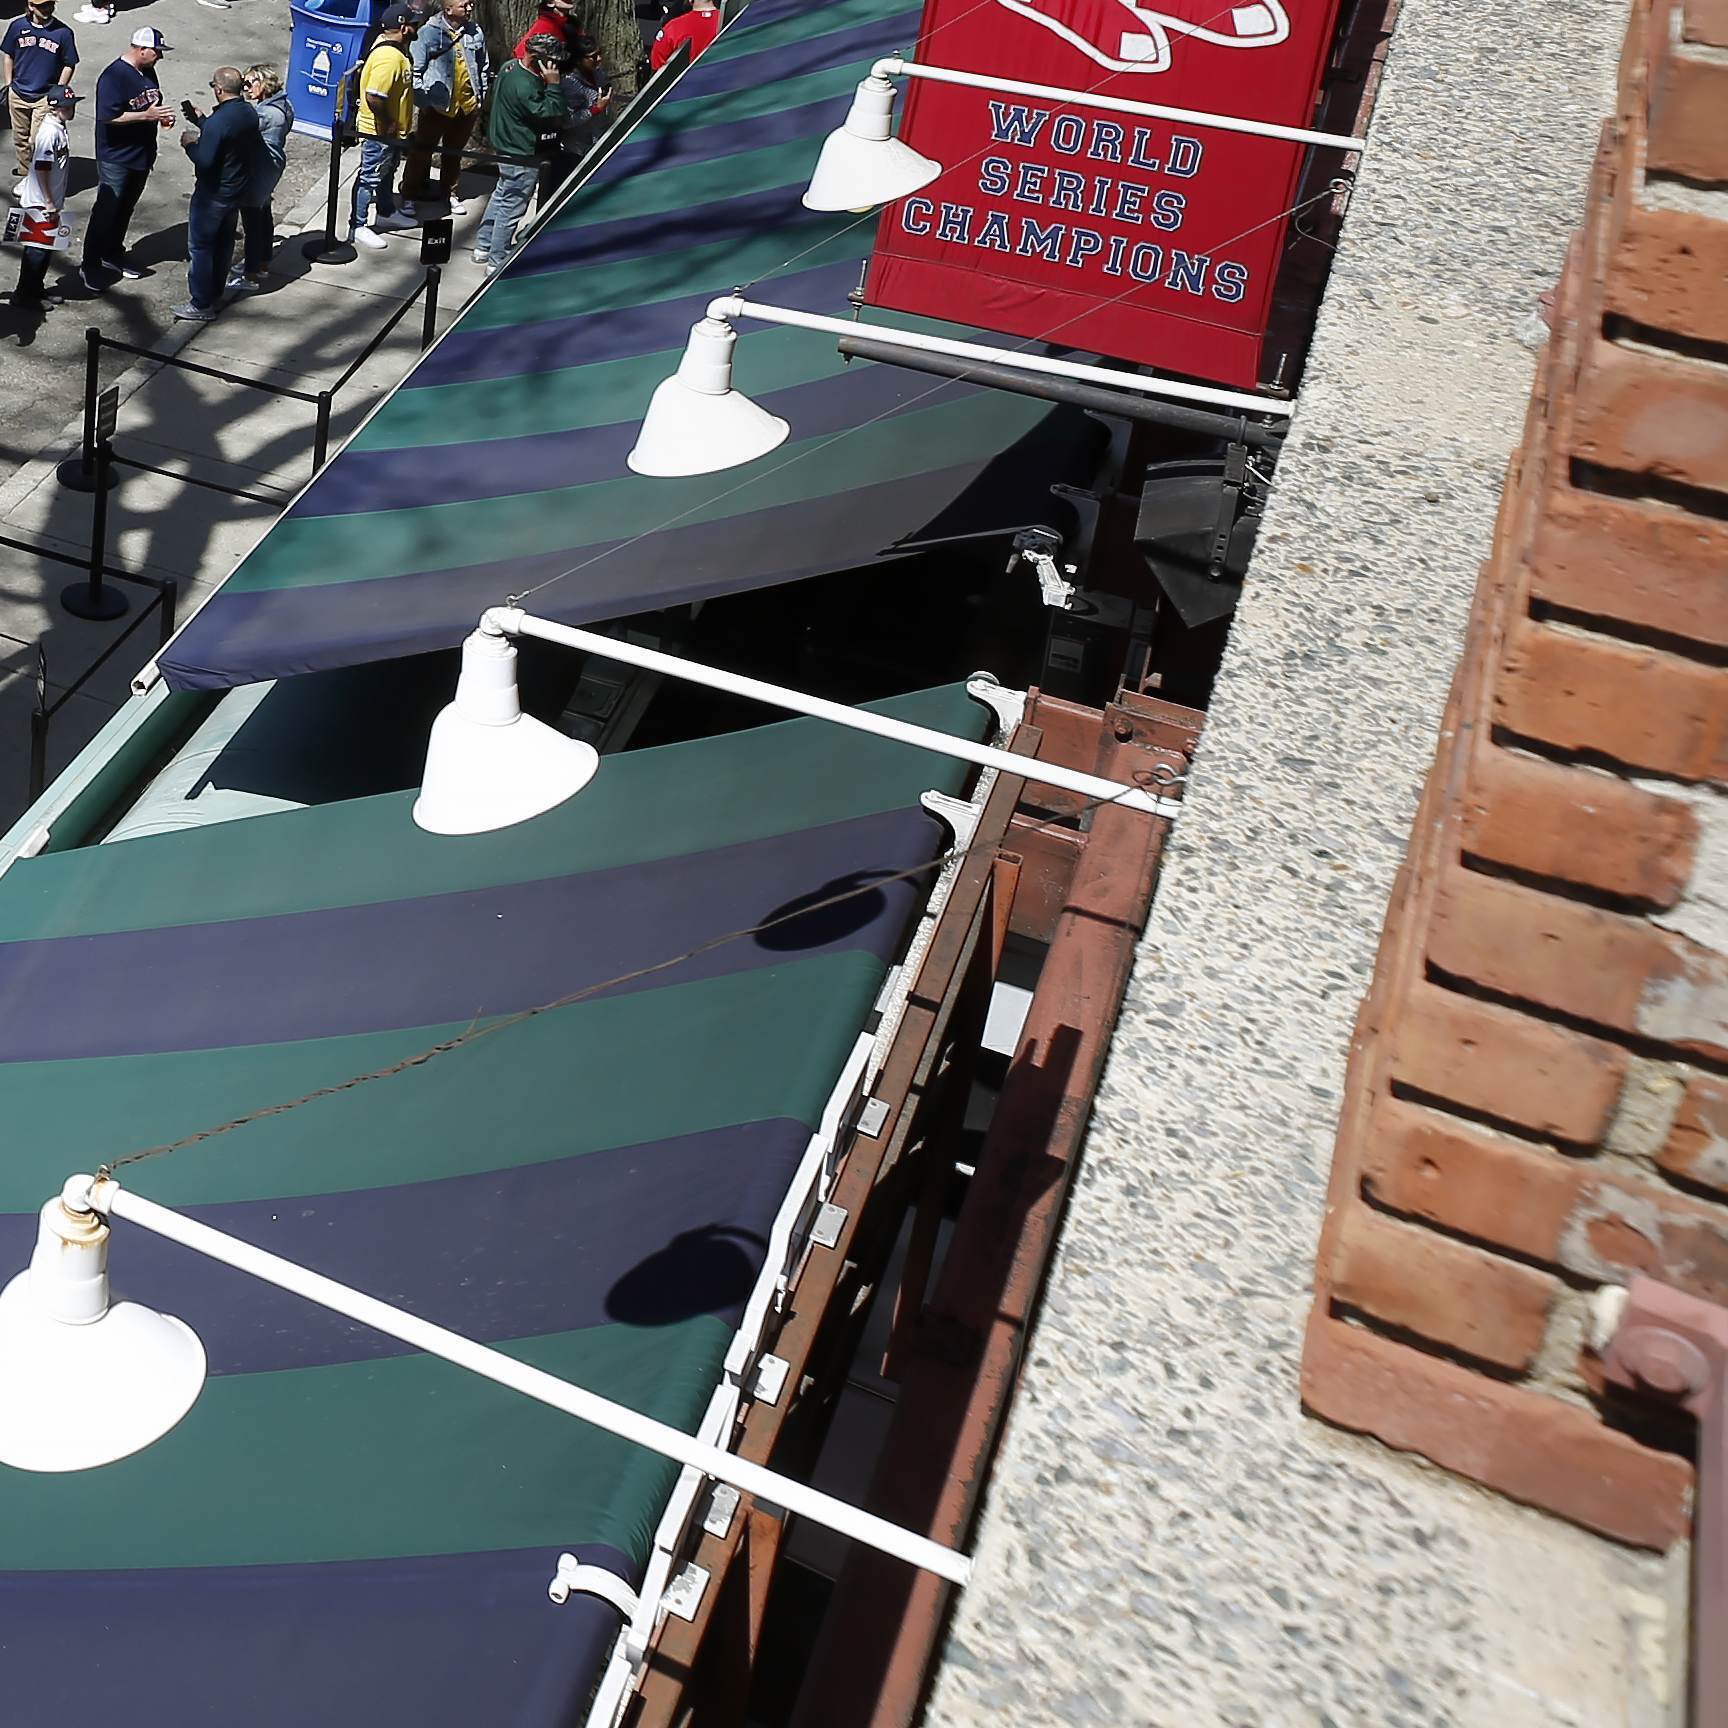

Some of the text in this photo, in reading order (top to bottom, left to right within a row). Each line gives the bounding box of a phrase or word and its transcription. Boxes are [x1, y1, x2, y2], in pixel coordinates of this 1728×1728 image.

[541, 132, 557, 142] Exit
[987, 100, 1204, 179] WORLD
[979, 156, 1187, 233] SERIES
[427, 235, 447, 246] Exit
[901, 197, 1249, 304] CHAMPIONS
